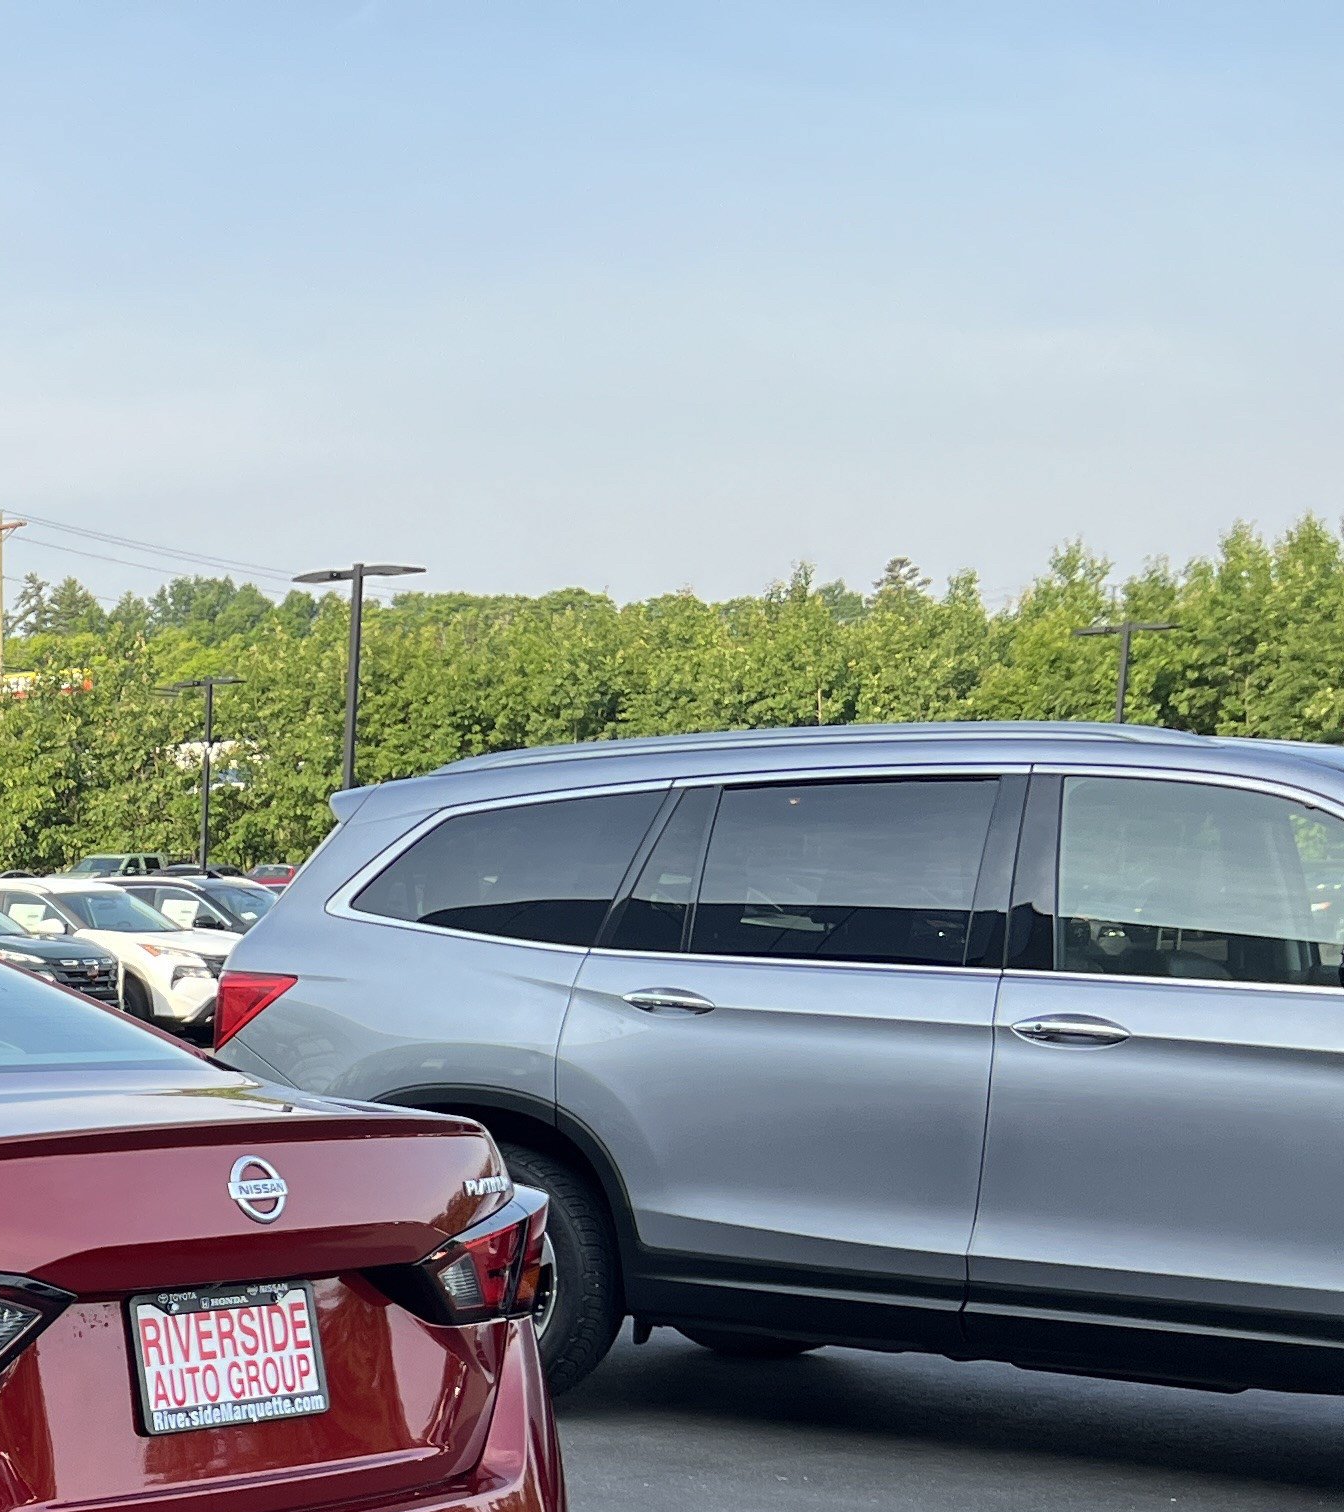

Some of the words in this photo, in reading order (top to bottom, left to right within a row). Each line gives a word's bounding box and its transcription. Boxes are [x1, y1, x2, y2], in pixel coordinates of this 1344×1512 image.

[238, 1182, 285, 1195] NISSAN
[168, 1291, 198, 1302] TOYOTA
[210, 1295, 250, 1307] HONDA
[139, 1301, 311, 1368] RIVERSIDE
[153, 1363, 220, 1410] AUTO
[227, 1353, 311, 1400] GROUP
